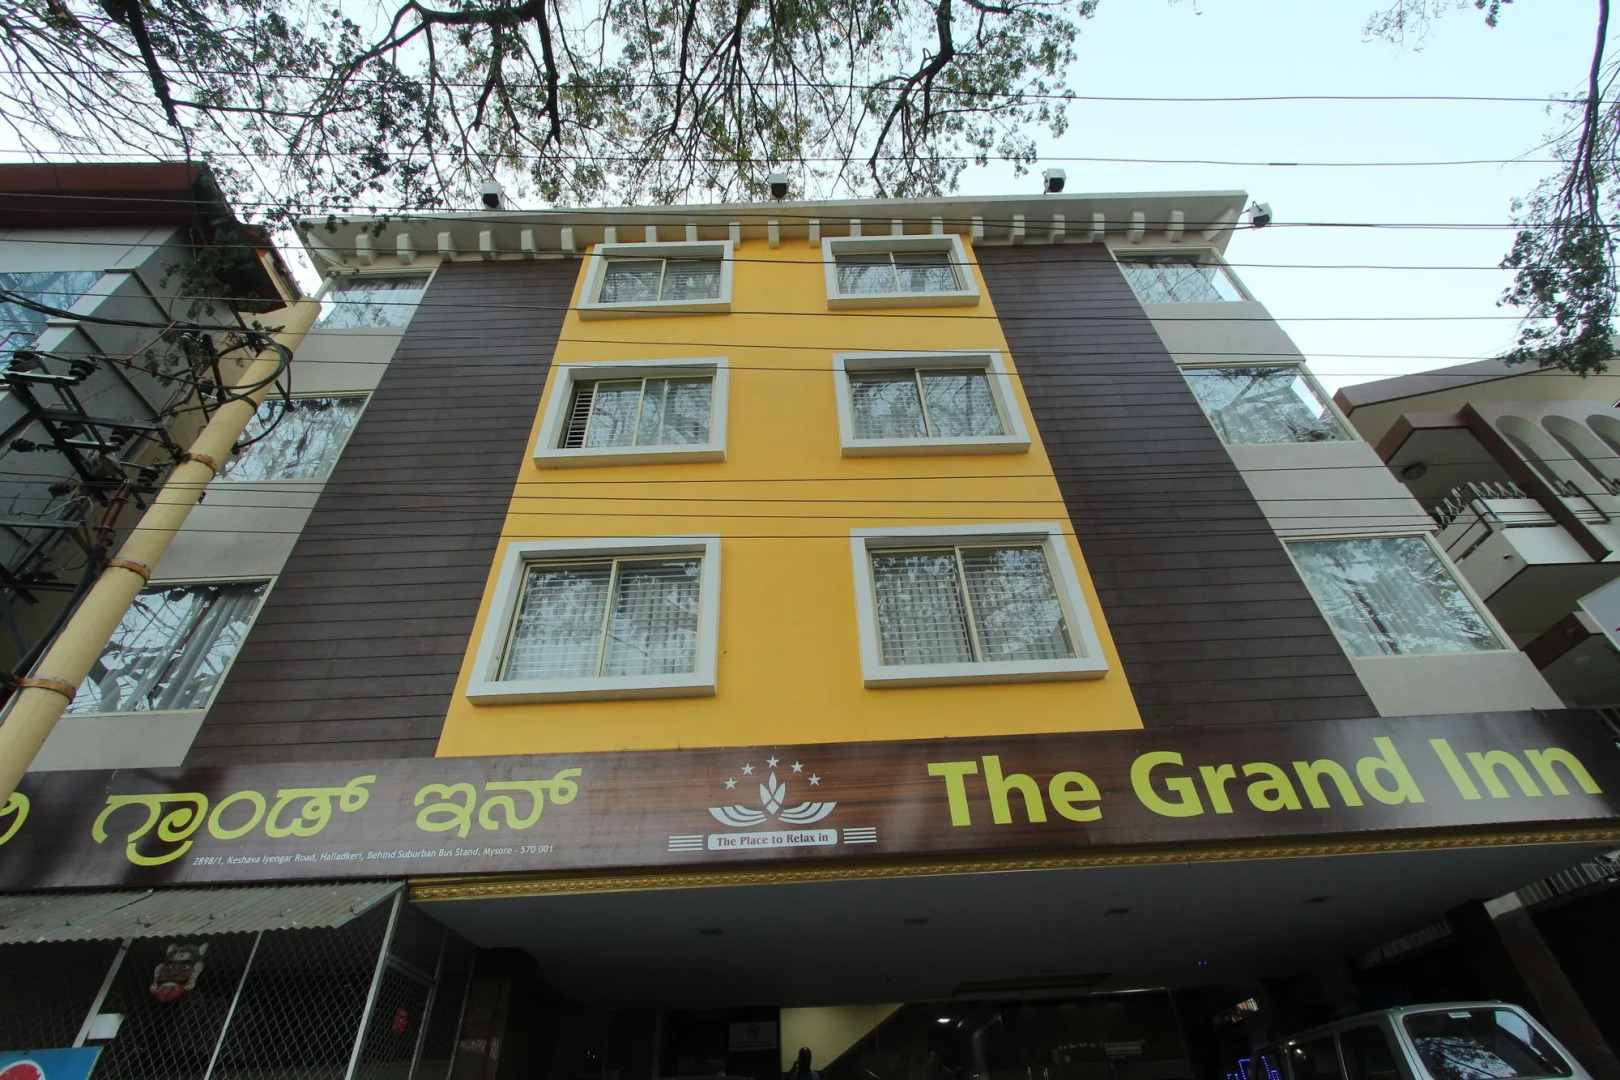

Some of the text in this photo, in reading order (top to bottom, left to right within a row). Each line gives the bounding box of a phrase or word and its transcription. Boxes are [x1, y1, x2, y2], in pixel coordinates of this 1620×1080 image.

[414, 768, 582, 838] ಇನ್
[926, 736, 1603, 827] The Grand Inn
[226, 855, 261, 865] Keshava
[262, 854, 292, 865] Iyengar
[294, 852, 317, 863] Road,
[366, 850, 397, 860] Behind
[397, 849, 437, 859] Suburban
[438, 848, 453, 857] Bus
[455, 847, 481, 857] Stand,
[483, 847, 513, 857] Mysore
[520, 845, 536, 854] 570
[538, 844, 553, 853] 001
[717, 832, 829, 847] The Place to Relax in
